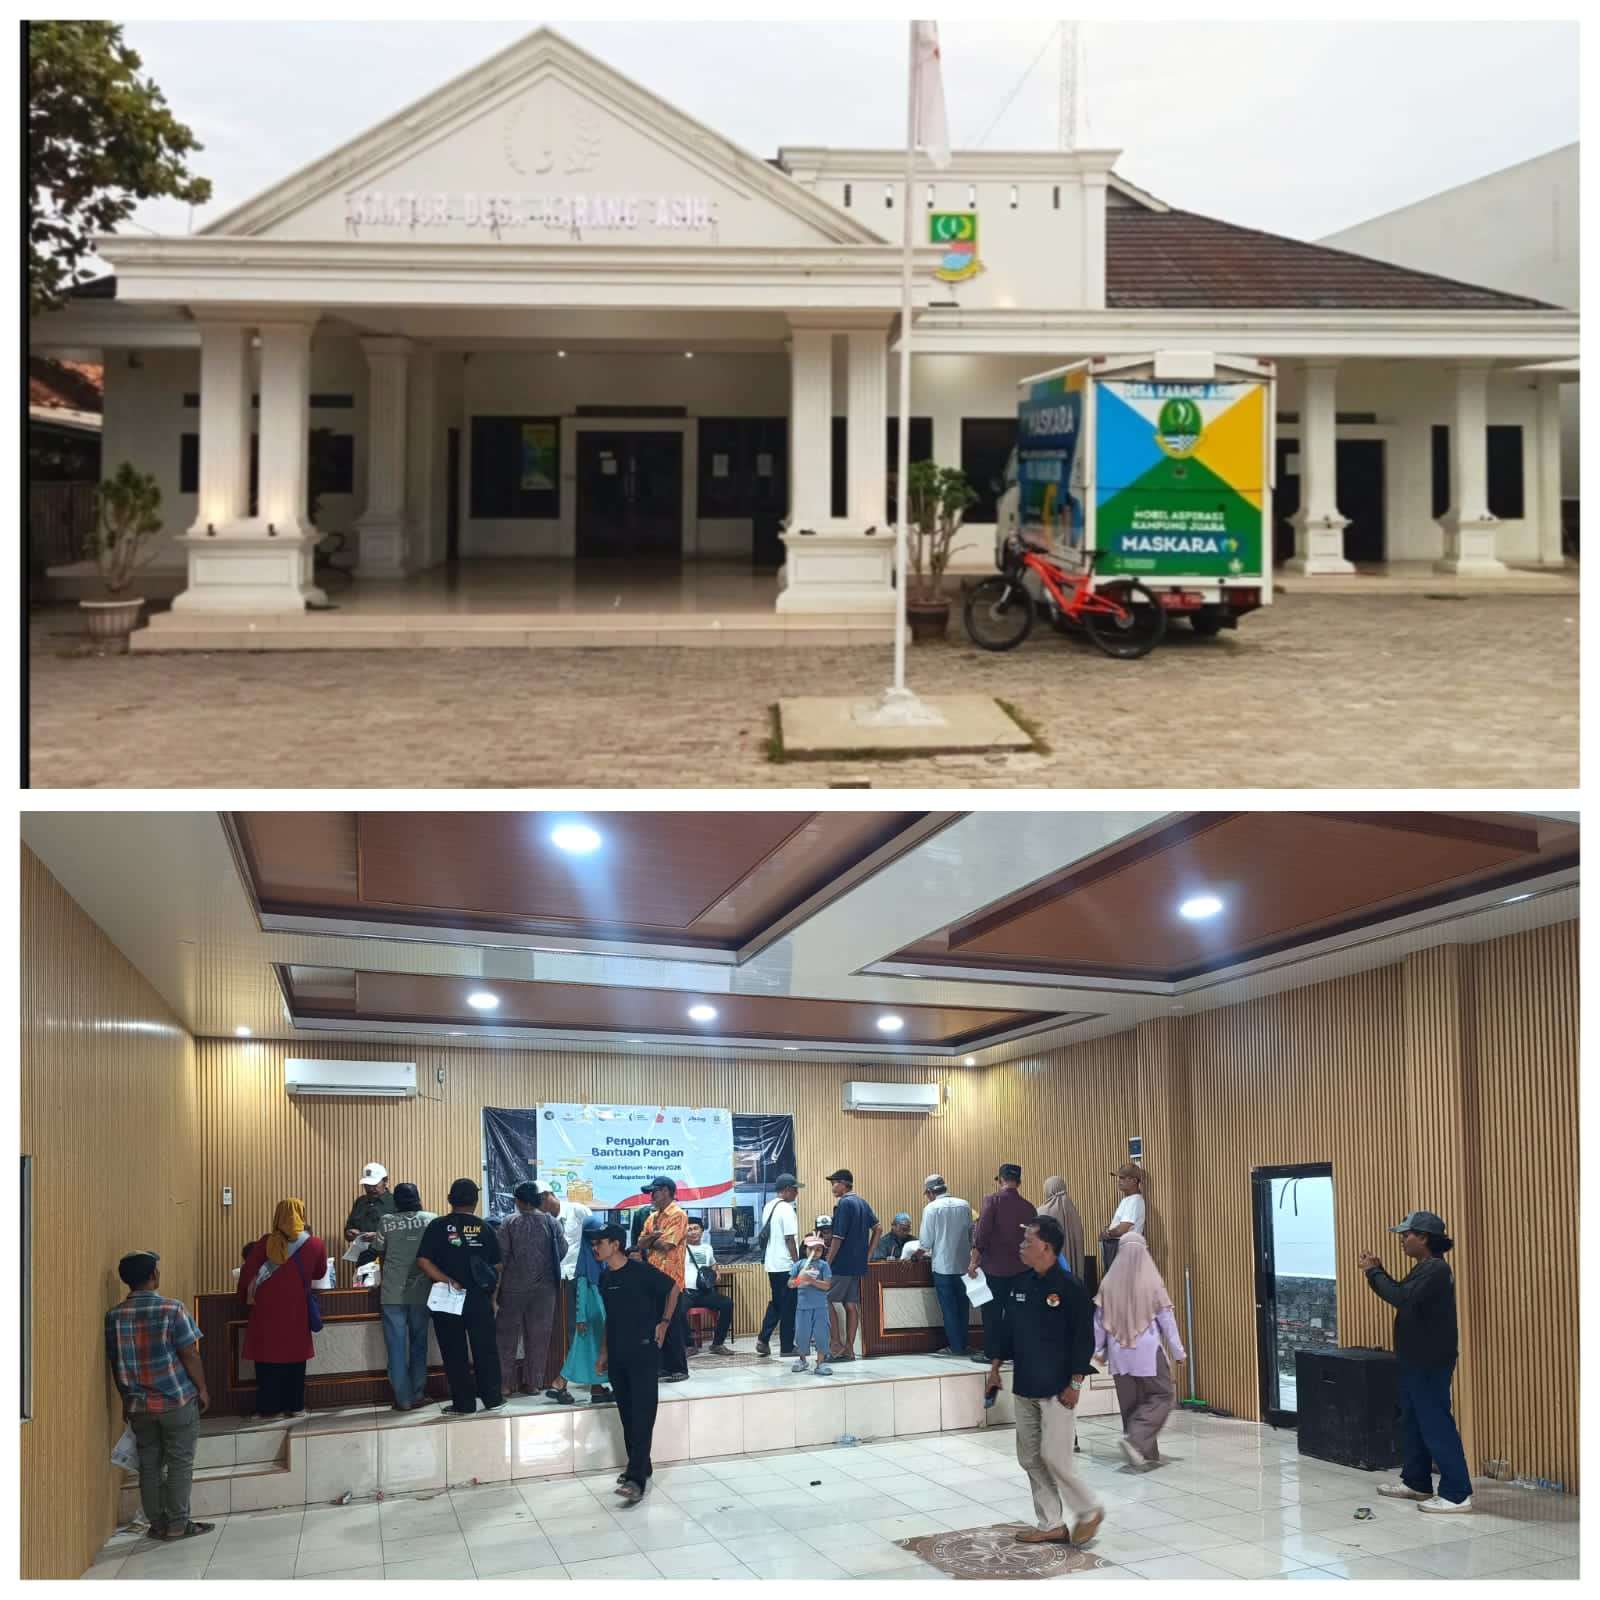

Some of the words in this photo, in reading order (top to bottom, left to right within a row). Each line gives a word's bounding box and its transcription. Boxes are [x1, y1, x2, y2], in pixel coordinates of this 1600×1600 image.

[347, 191, 449, 227] KANTOR
[464, 192, 527, 228] DESA
[543, 193, 638, 230] KARANG
[652, 194, 713, 230] ASIH
[1133, 510, 1168, 519] MOBIL
[1171, 511, 1225, 520] ASPIRASI
[1131, 521, 1187, 530] KAMPUNG
[1190, 522, 1226, 531] JUARA
[1121, 536, 1219, 553] MASKARA
[606, 1136, 670, 1148] Penyaluran
[591, 1147, 641, 1157] Bantuan
[643, 1148, 684, 1160] Pangan
